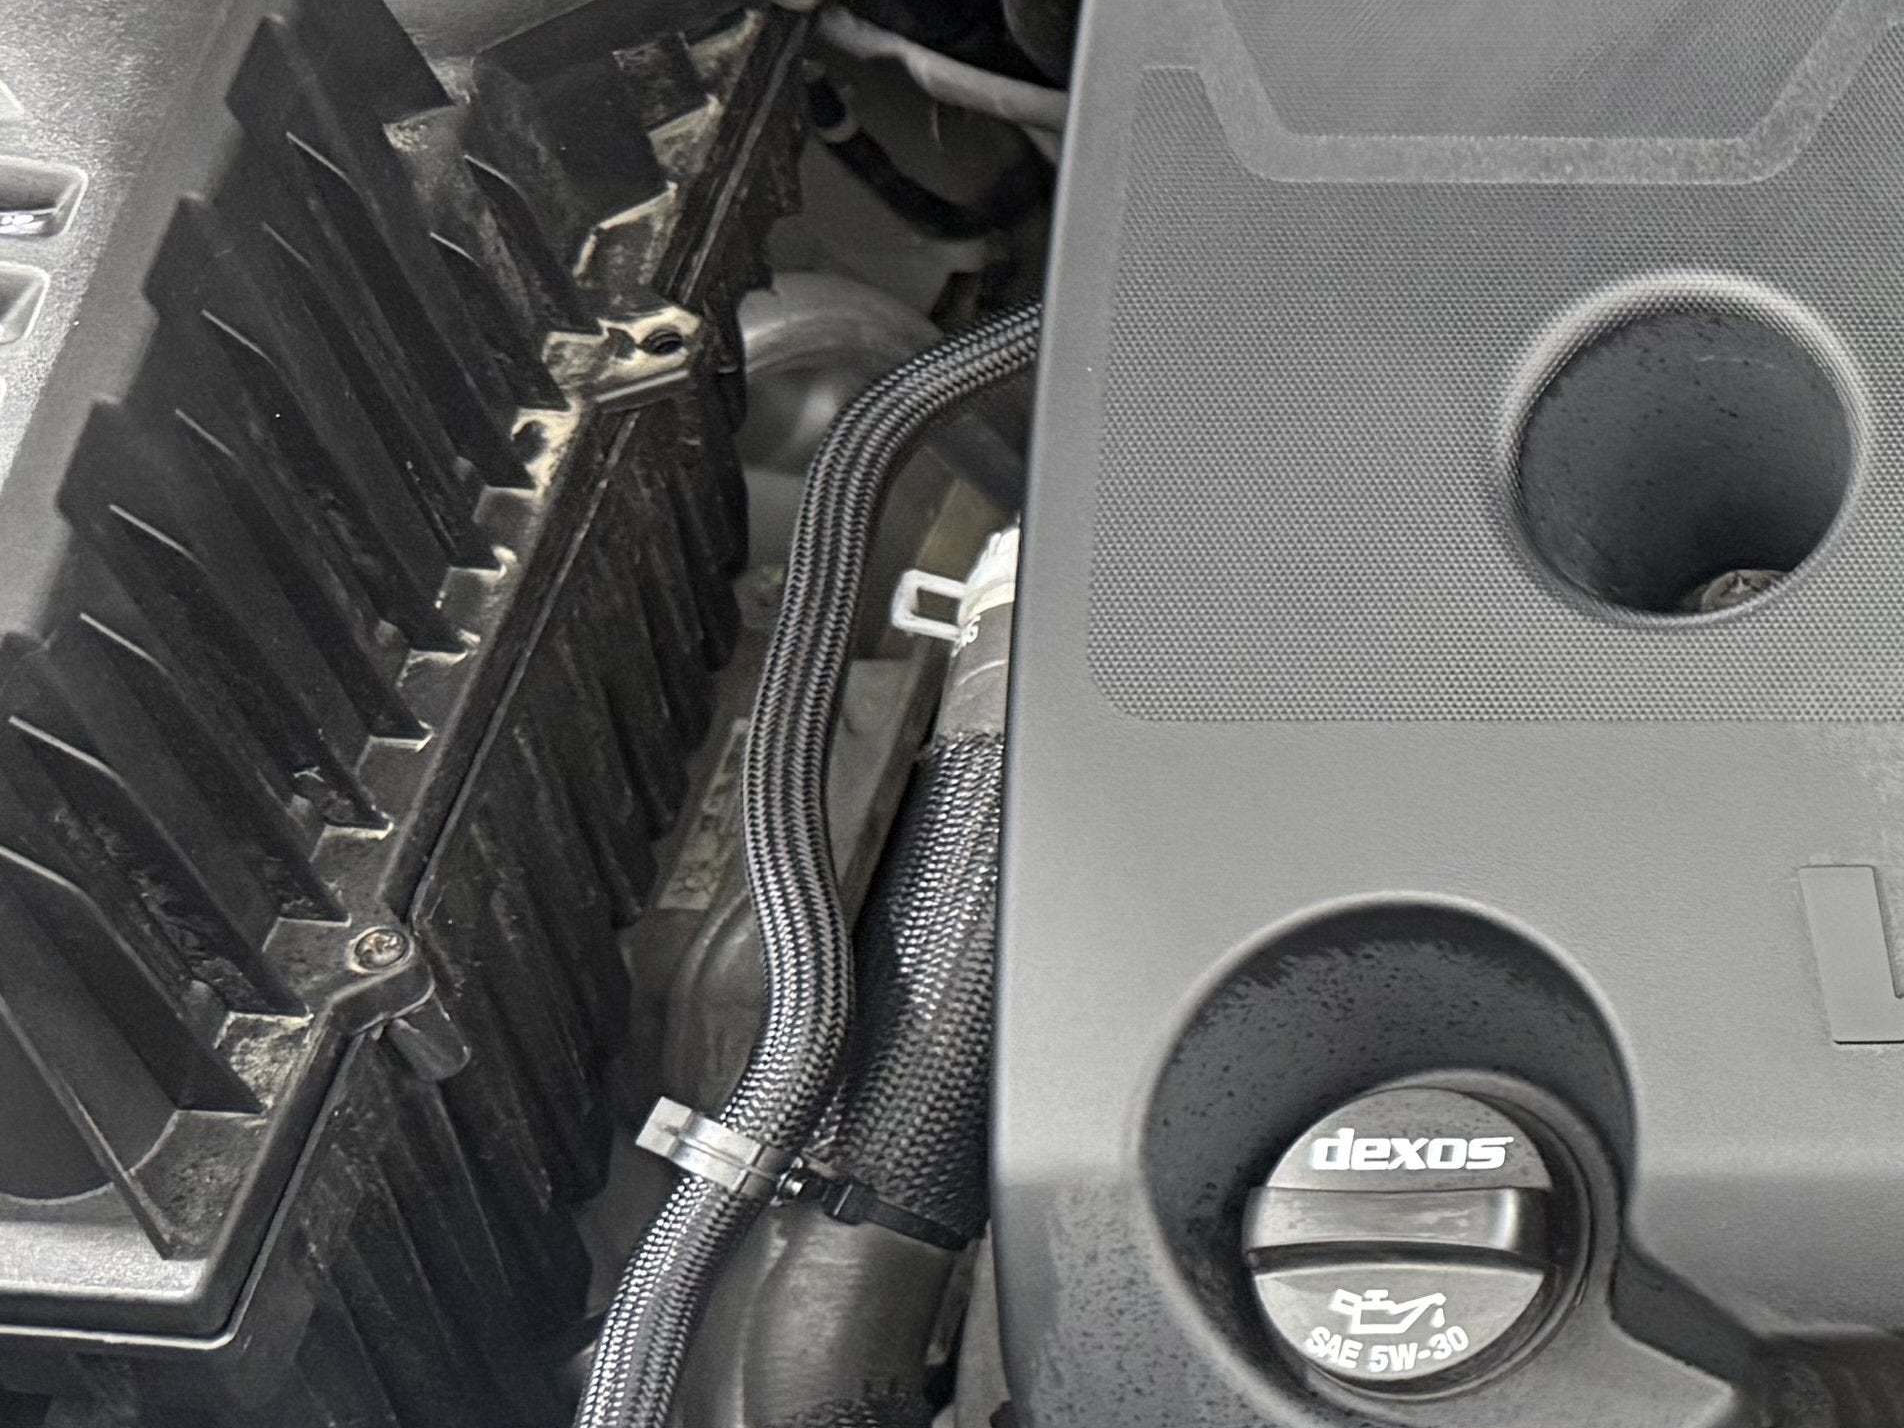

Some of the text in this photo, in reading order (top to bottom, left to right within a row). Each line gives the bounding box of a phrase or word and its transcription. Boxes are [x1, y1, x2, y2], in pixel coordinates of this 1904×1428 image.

[1311, 1127, 1506, 1171] dexos
[1306, 1325, 1470, 1373] SAE 5W-30
